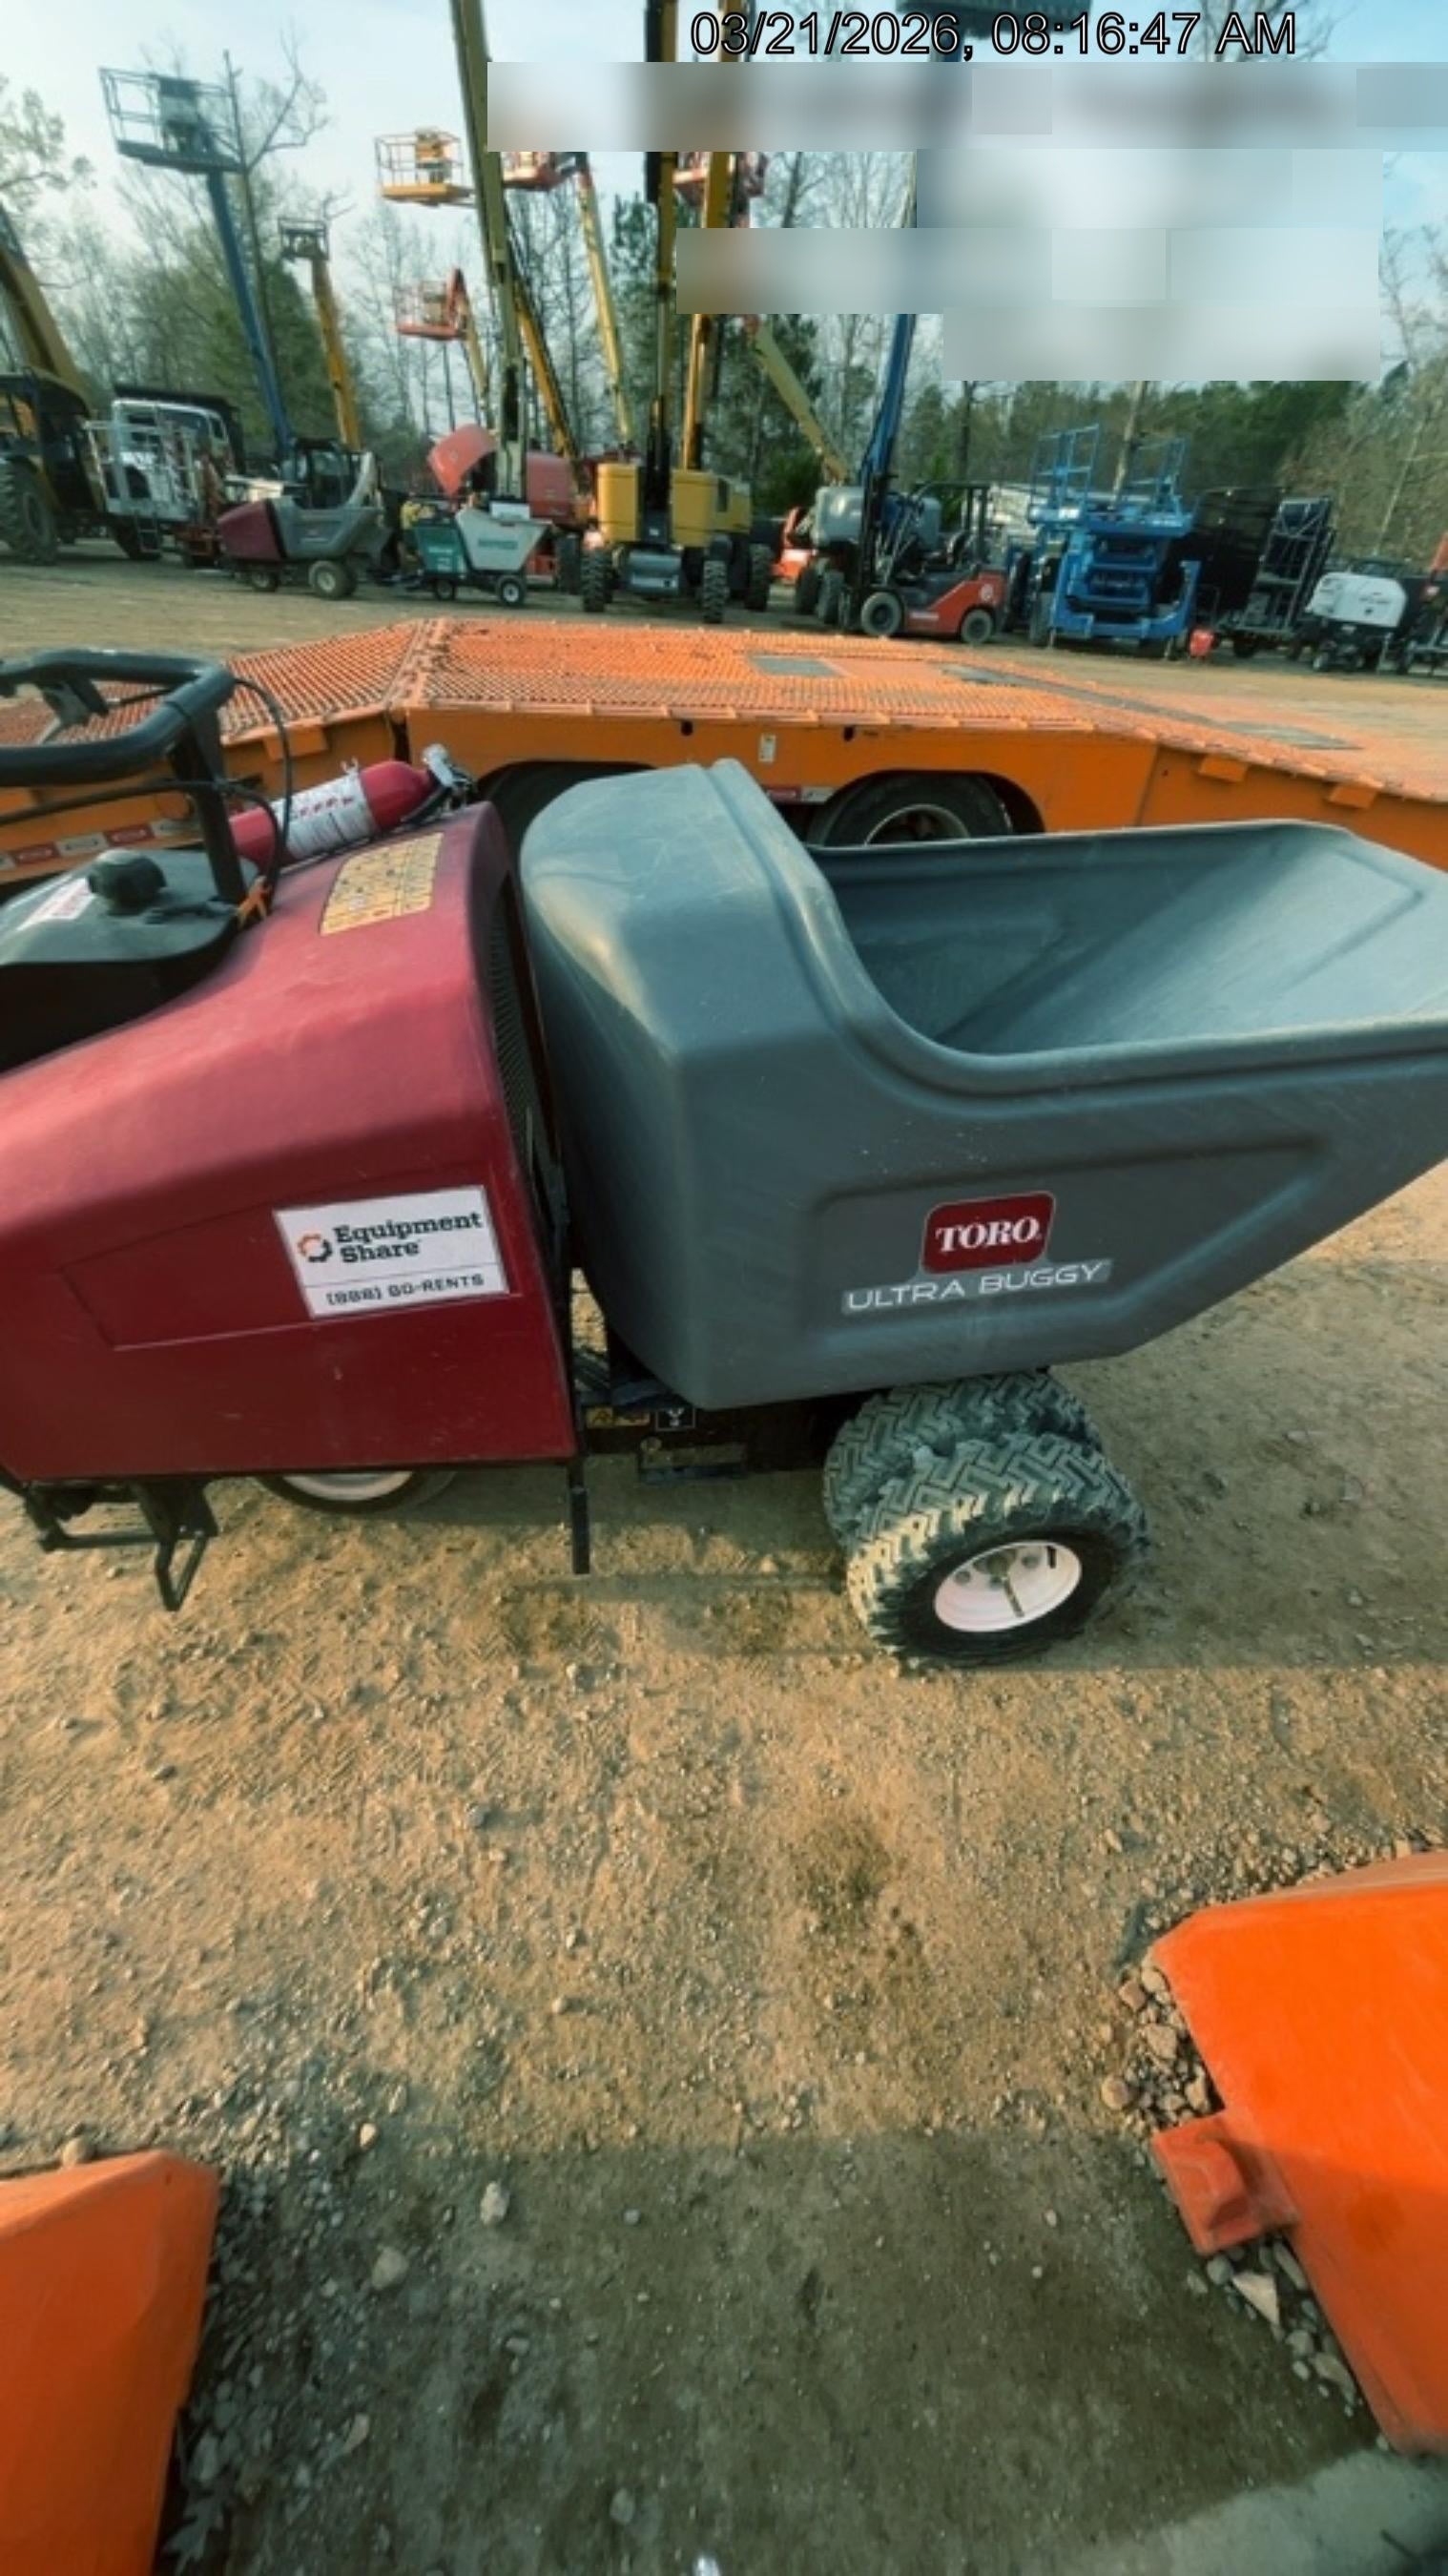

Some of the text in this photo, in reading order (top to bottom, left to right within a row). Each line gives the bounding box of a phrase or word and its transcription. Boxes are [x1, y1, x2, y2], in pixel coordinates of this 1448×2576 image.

[332, 1212, 483, 1243] Equipment
[935, 1216, 1038, 1253] TORO
[340, 1240, 419, 1263] Share
[847, 1261, 1103, 1310] ULTRA BUGGY
